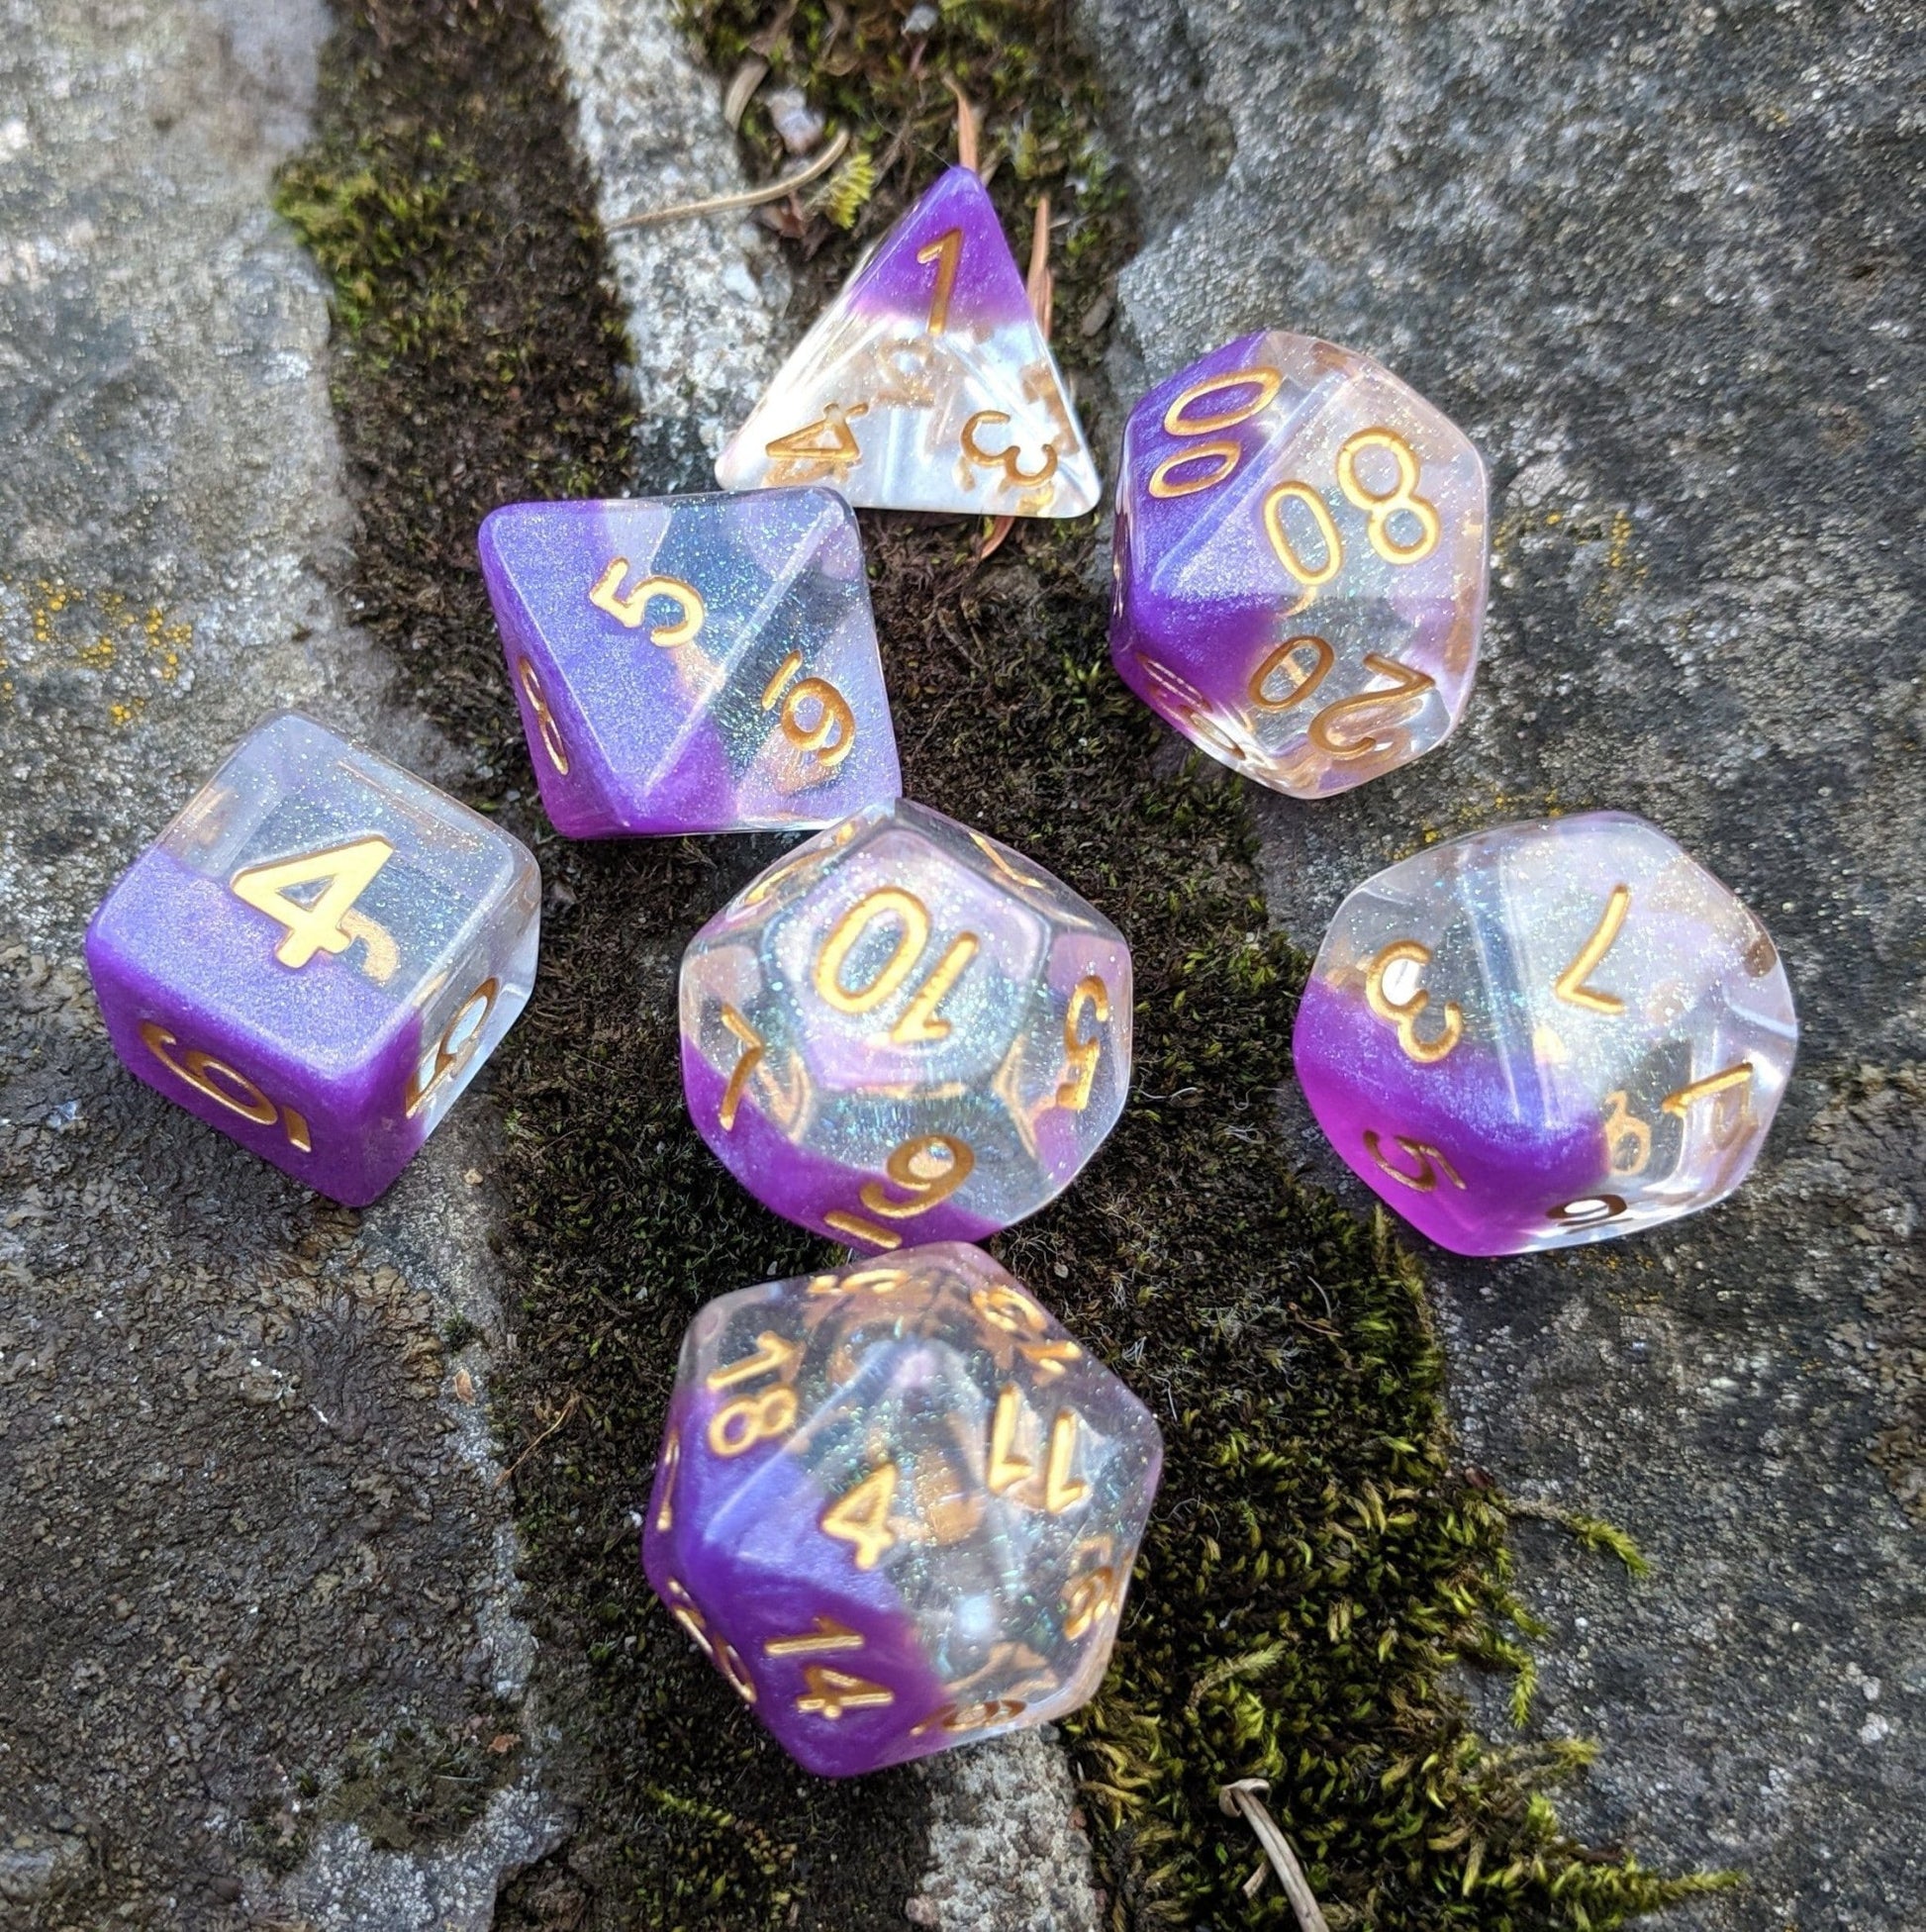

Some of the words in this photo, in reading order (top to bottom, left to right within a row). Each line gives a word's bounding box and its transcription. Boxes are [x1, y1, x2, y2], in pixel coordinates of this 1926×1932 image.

[916, 227, 964, 338] 1
[765, 402, 870, 461] 4
[960, 410, 1059, 489] 3
[1148, 365, 1284, 500] 00
[589, 556, 706, 649] 5
[229, 832, 397, 970] 4
[812, 884, 981, 1045] 10
[1366, 939, 1465, 1063] 3
[1055, 973, 1109, 1113] 5
[706, 1330, 800, 1458] 18
[989, 1382, 1091, 1516] 11
[820, 1462, 899, 1572] 4
[764, 1614, 895, 1720] 14
